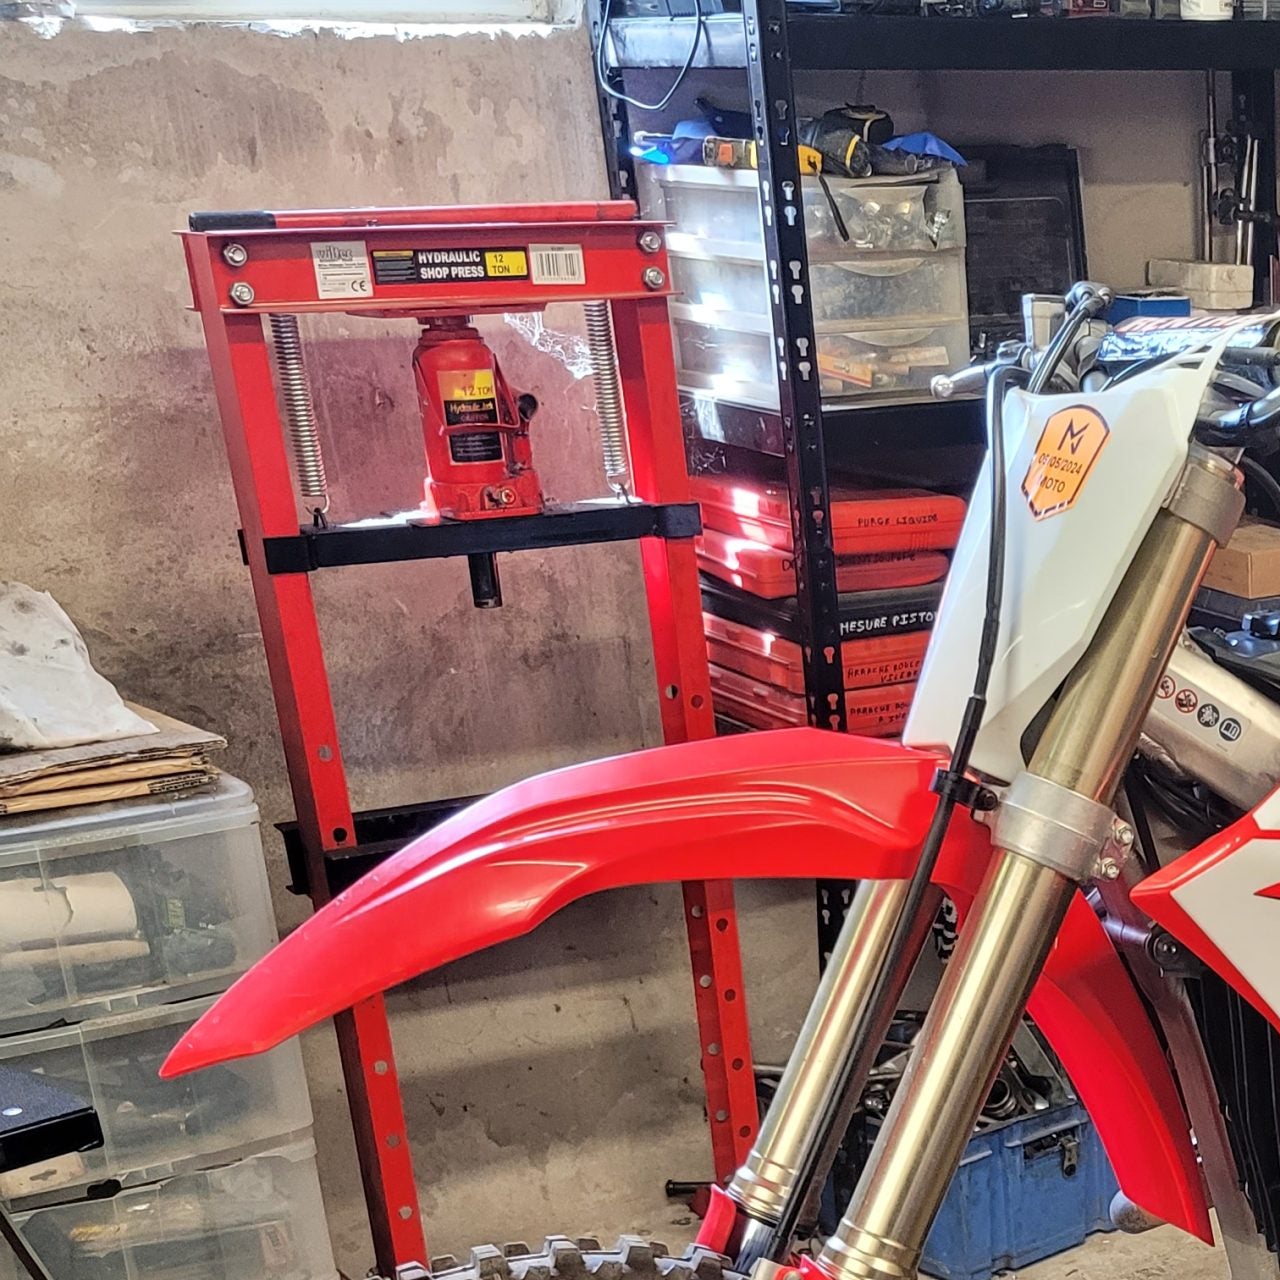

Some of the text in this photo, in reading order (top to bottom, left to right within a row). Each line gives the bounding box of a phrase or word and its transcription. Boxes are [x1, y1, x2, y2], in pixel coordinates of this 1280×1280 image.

[418, 251, 503, 264] HYDRAULIC 12
[420, 265, 449, 280] SHOP
[451, 265, 485, 279] PRESS
[492, 265, 511, 274] TON
[1037, 474, 1066, 493] MOTO
[840, 617, 887, 636] MESURE
